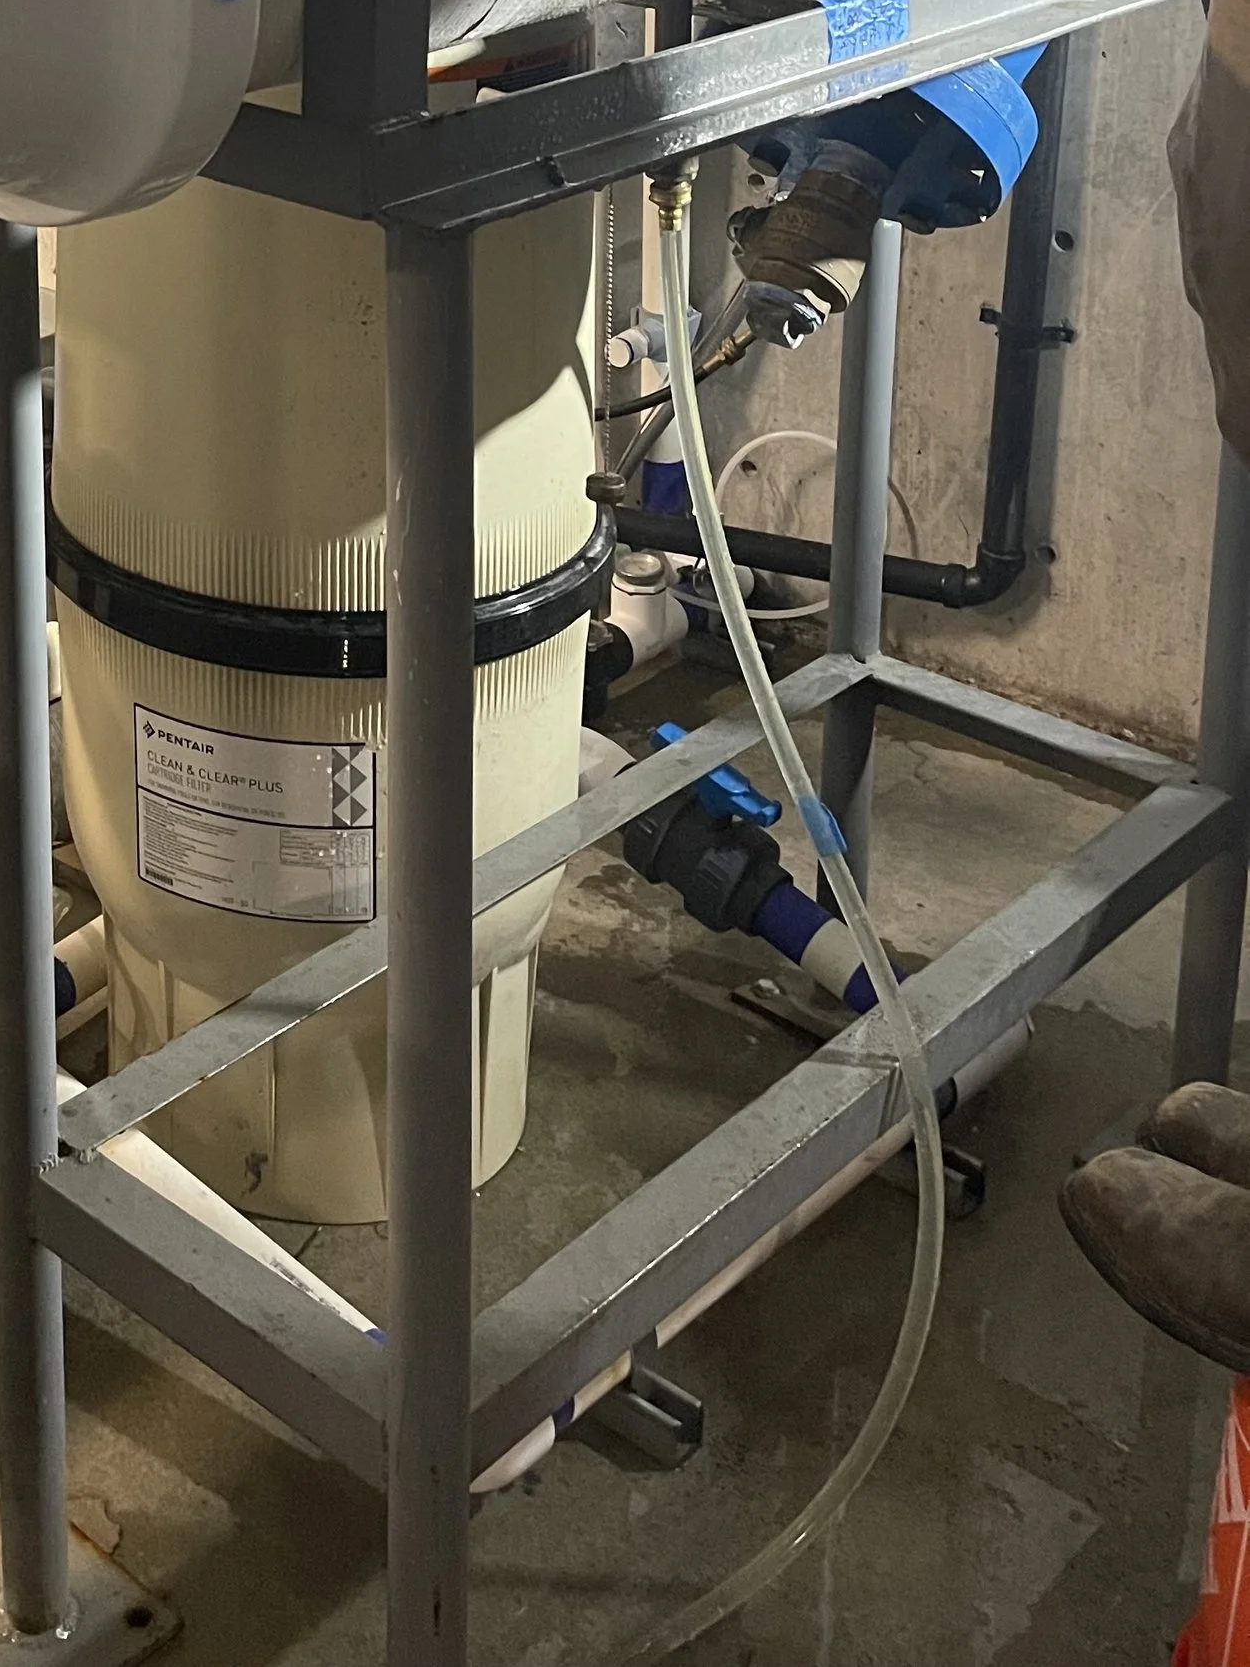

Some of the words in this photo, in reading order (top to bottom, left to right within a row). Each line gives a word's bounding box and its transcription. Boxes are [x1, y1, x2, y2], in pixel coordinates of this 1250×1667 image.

[158, 730, 215, 755] PENTAIR
[147, 750, 183, 772] CLEAN
[187, 765, 195, 775] &
[249, 778, 283, 794] PLUS
[186, 777, 211, 793] FILTER
